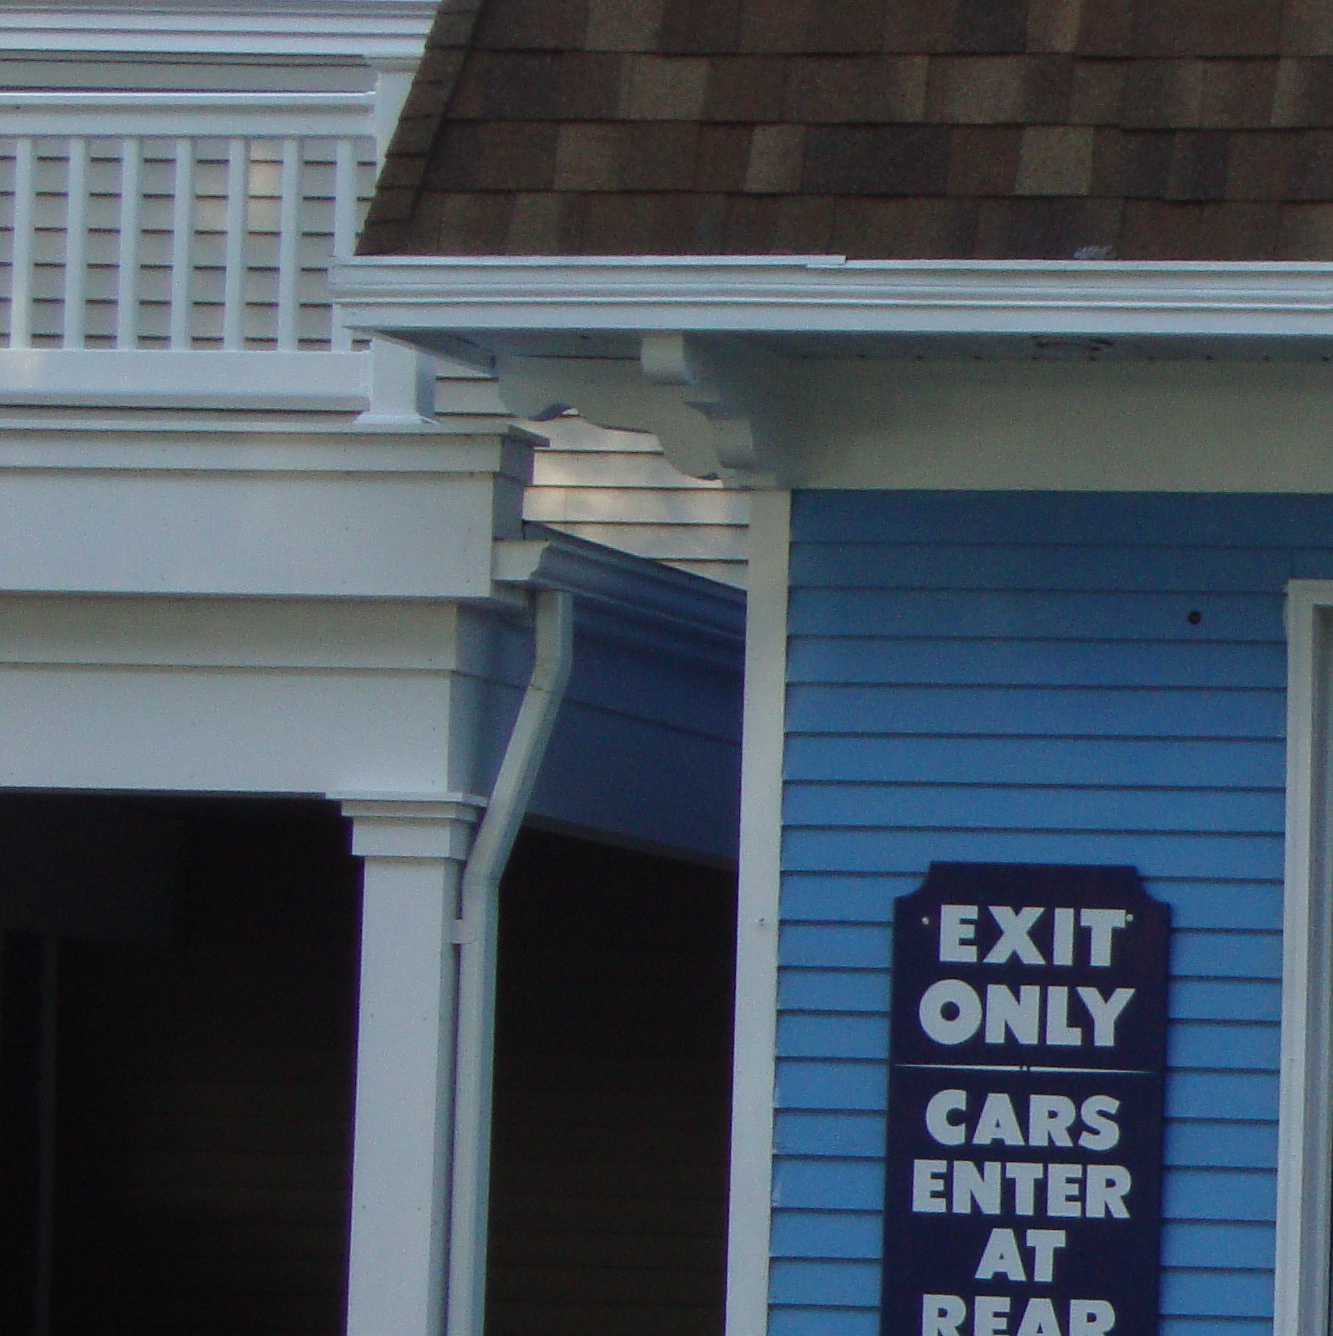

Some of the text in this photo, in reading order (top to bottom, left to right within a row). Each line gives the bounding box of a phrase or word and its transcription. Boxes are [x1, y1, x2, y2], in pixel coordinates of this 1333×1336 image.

[939, 904, 1127, 966] EXIT
[919, 979, 1136, 1047] ONLY
[926, 1089, 1121, 1151] CARS
[912, 1159, 1132, 1218] ENTER
[975, 1228, 1066, 1282] AT
